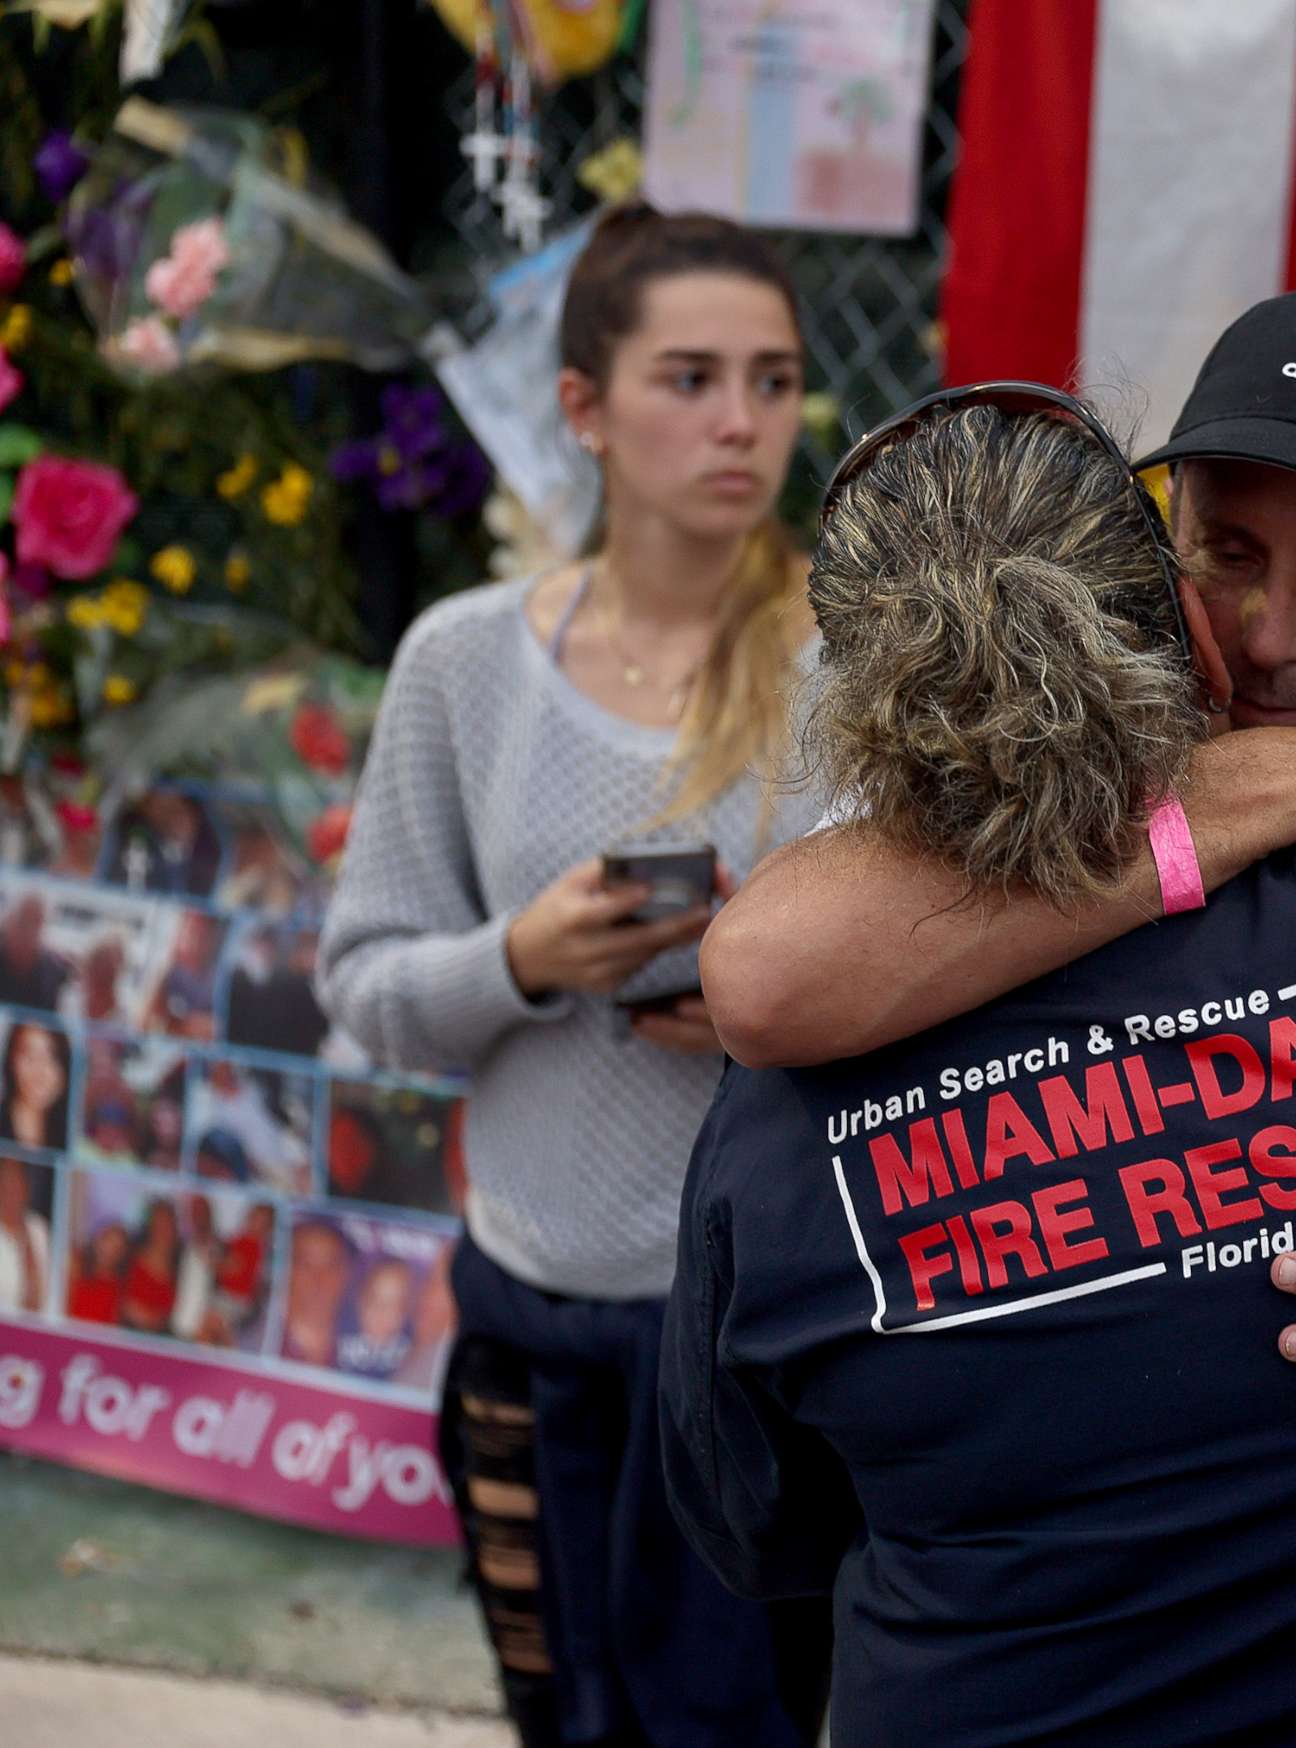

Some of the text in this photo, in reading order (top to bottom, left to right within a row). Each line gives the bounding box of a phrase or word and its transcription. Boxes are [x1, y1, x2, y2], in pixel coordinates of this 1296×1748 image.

[828, 988, 1270, 1144] Urban Search & Rescue
[897, 1178, 1110, 1312] FIRE
[60, 1353, 167, 1442] for
[172, 1388, 275, 1470] all
